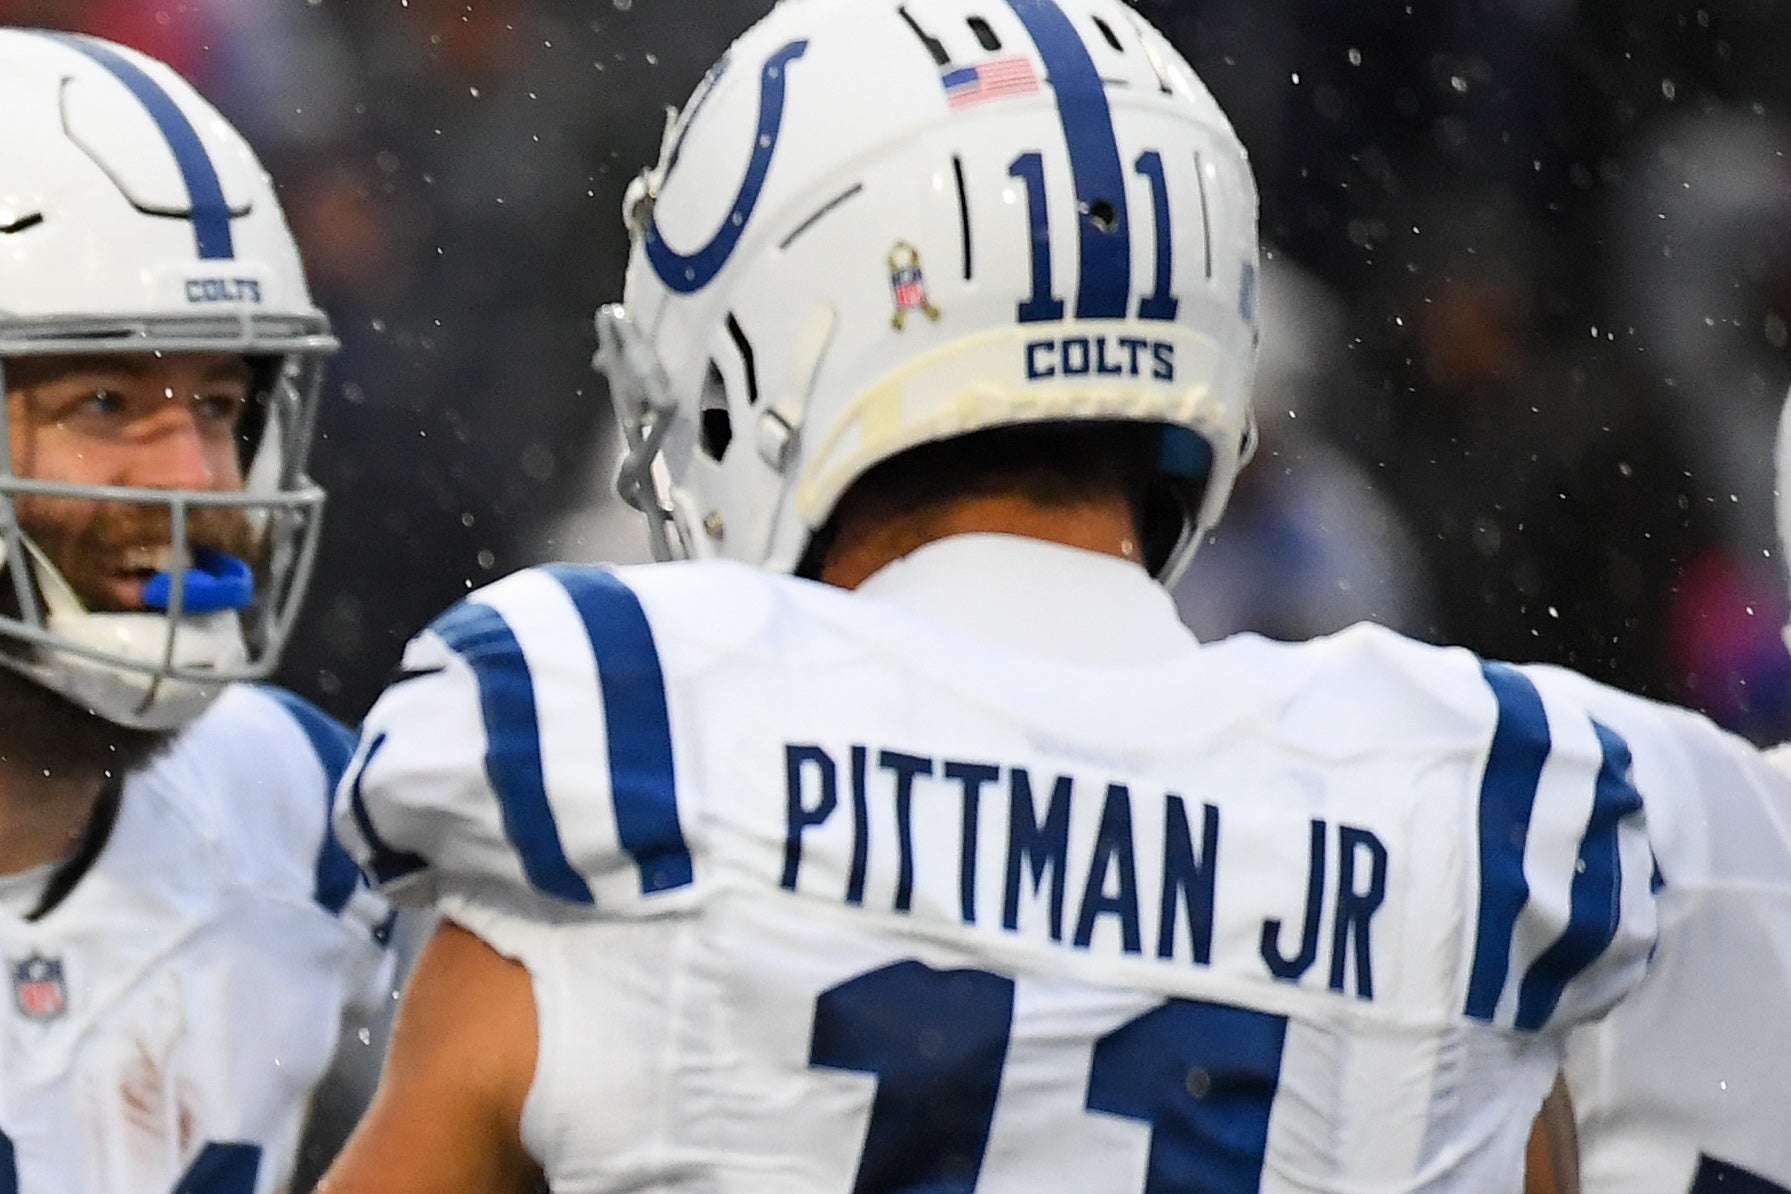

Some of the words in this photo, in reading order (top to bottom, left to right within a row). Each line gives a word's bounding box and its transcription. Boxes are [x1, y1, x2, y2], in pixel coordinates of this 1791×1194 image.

[1007, 151, 1179, 324] 11
[1024, 336, 1175, 382] COLTS
[778, 741, 1221, 967] PITTMAN
[1259, 818, 1389, 1002] JR
